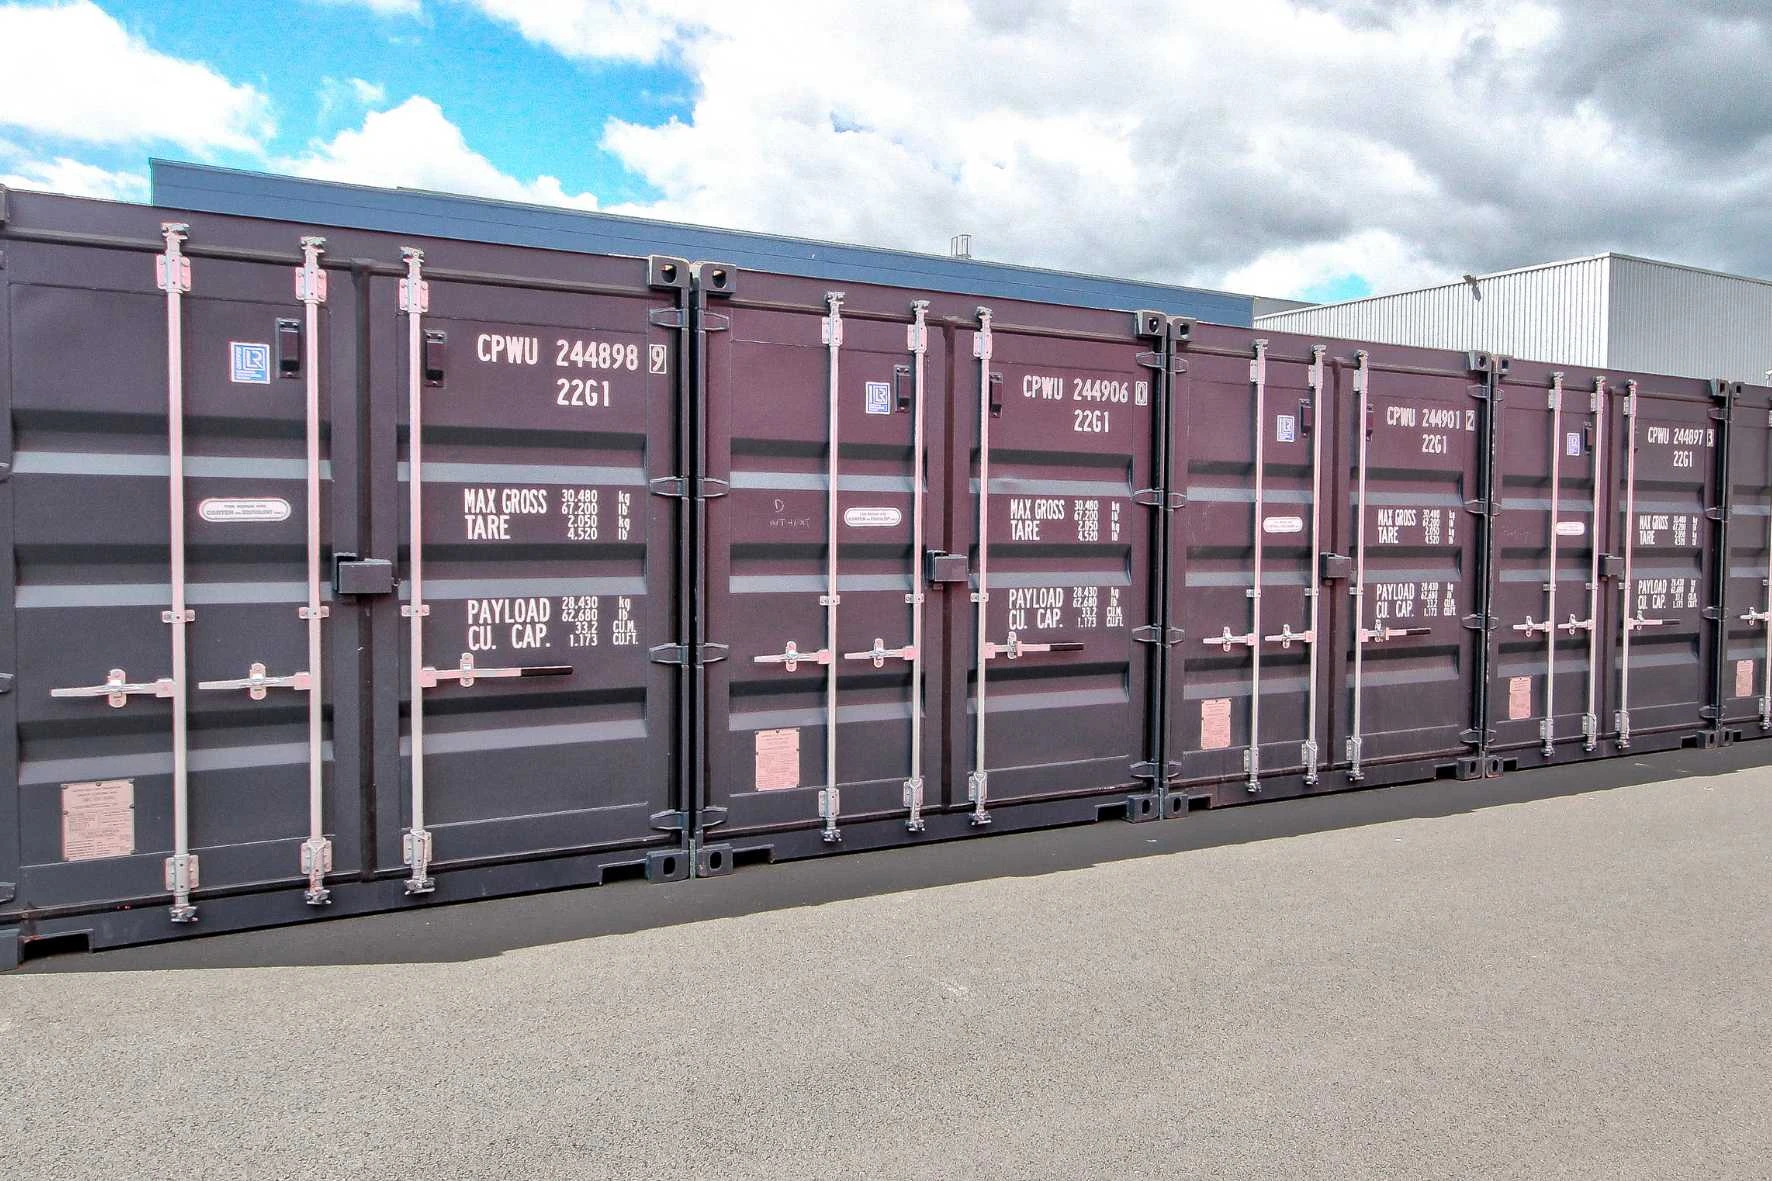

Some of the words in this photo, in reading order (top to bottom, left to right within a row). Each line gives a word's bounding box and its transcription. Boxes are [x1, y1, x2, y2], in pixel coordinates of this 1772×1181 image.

[477, 333, 539, 365] CPWU
[555, 338, 639, 371] 244898
[556, 377, 610, 408] 22G1
[1023, 374, 1063, 400] CPWU
[1073, 378, 1129, 403] 244906
[1074, 409, 1109, 433] 22G1
[1386, 406, 1416, 428] CPWU
[1422, 408, 1461, 430] 244901
[1422, 433, 1448, 454] 22G1
[1673, 450, 1693, 468] 22G1
[463, 488, 497, 514] MAX
[501, 488, 548, 514] GROSS
[560, 489, 598, 502] 30.480
[618, 490, 631, 506] kg
[561, 501, 598, 515] 67.200
[618, 504, 628, 516] lb
[1010, 499, 1032, 519] MAX
[1034, 499, 1065, 520] GROSS
[464, 514, 511, 541] TARE
[567, 514, 598, 528] 2.050
[618, 516, 631, 532] kg
[1378, 509, 1393, 526] MAX
[1394, 509, 1416, 526] GROSS
[567, 527, 598, 541] 4.520
[618, 529, 628, 541] lb
[1010, 520, 1040, 540] TARE
[1378, 526, 1399, 544] TARE
[1008, 588, 1064, 609] PAYLOAD
[1376, 583, 1415, 601] PAYLOAD
[467, 597, 551, 625] PAYLOAD
[561, 596, 598, 610] 28.430
[618, 595, 632, 611] kg
[561, 608, 598, 622] 62.680
[618, 608, 628, 621] lb
[1008, 610, 1028, 630] CU.
[1037, 608, 1063, 629] CAP.
[1376, 601, 1390, 618] CU.
[1395, 600, 1415, 618] CAP.
[468, 625, 497, 651] CU.
[511, 623, 551, 649] CAP.
[575, 621, 598, 635] 33.2
[569, 633, 598, 647] 1.173
